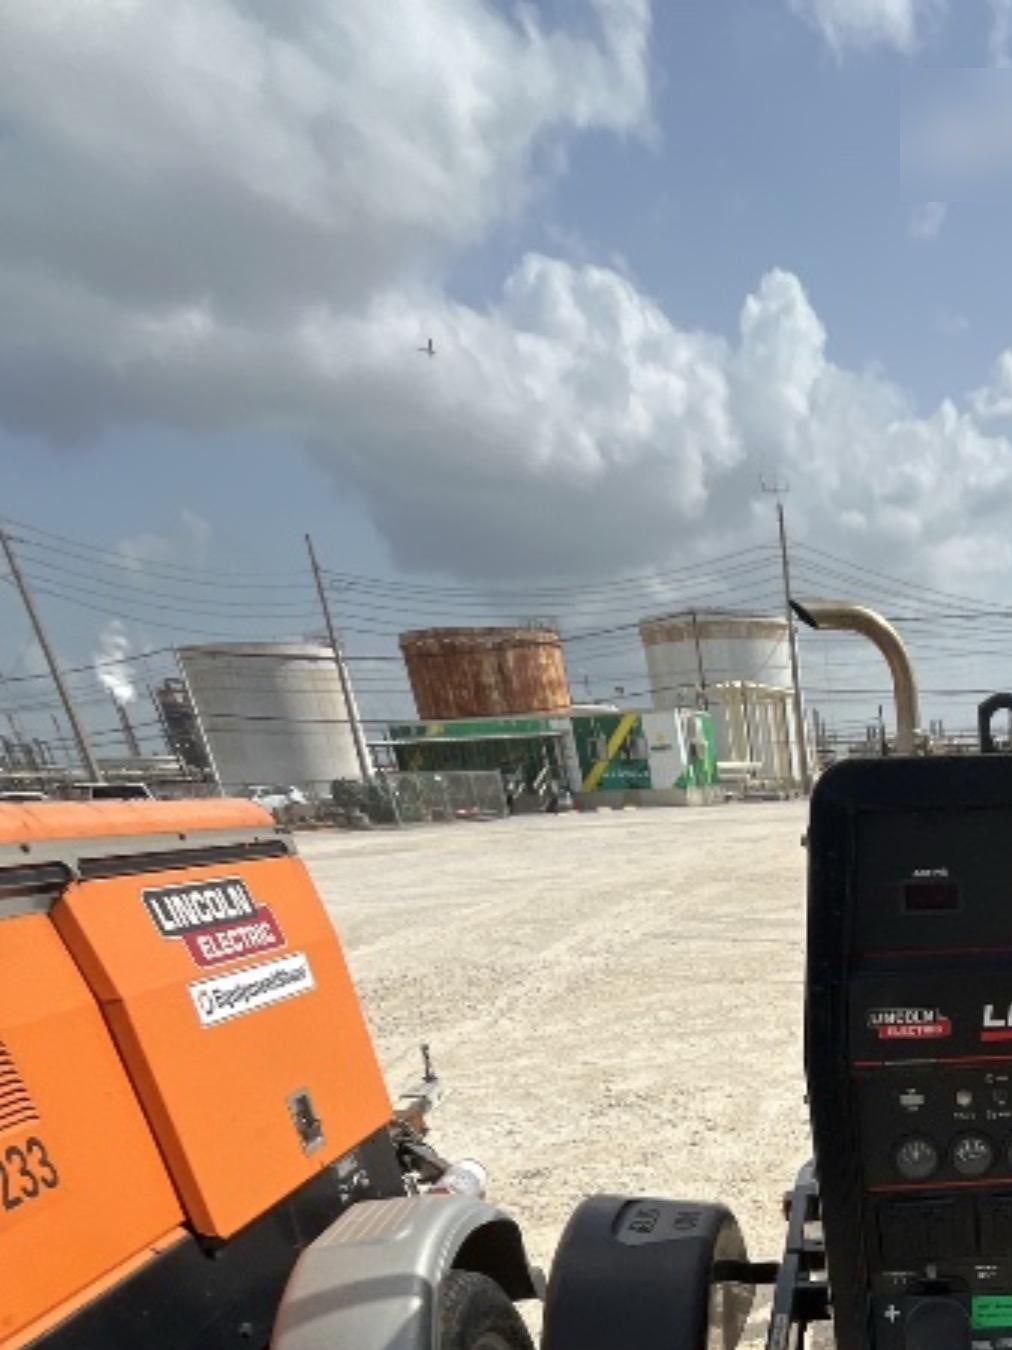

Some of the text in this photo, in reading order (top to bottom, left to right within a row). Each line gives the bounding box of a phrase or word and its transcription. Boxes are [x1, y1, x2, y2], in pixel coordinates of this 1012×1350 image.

[150, 884, 252, 931] LINCOLN
[196, 922, 277, 960] ELECTRIC
[870, 1009, 935, 1025] LINCOLN
